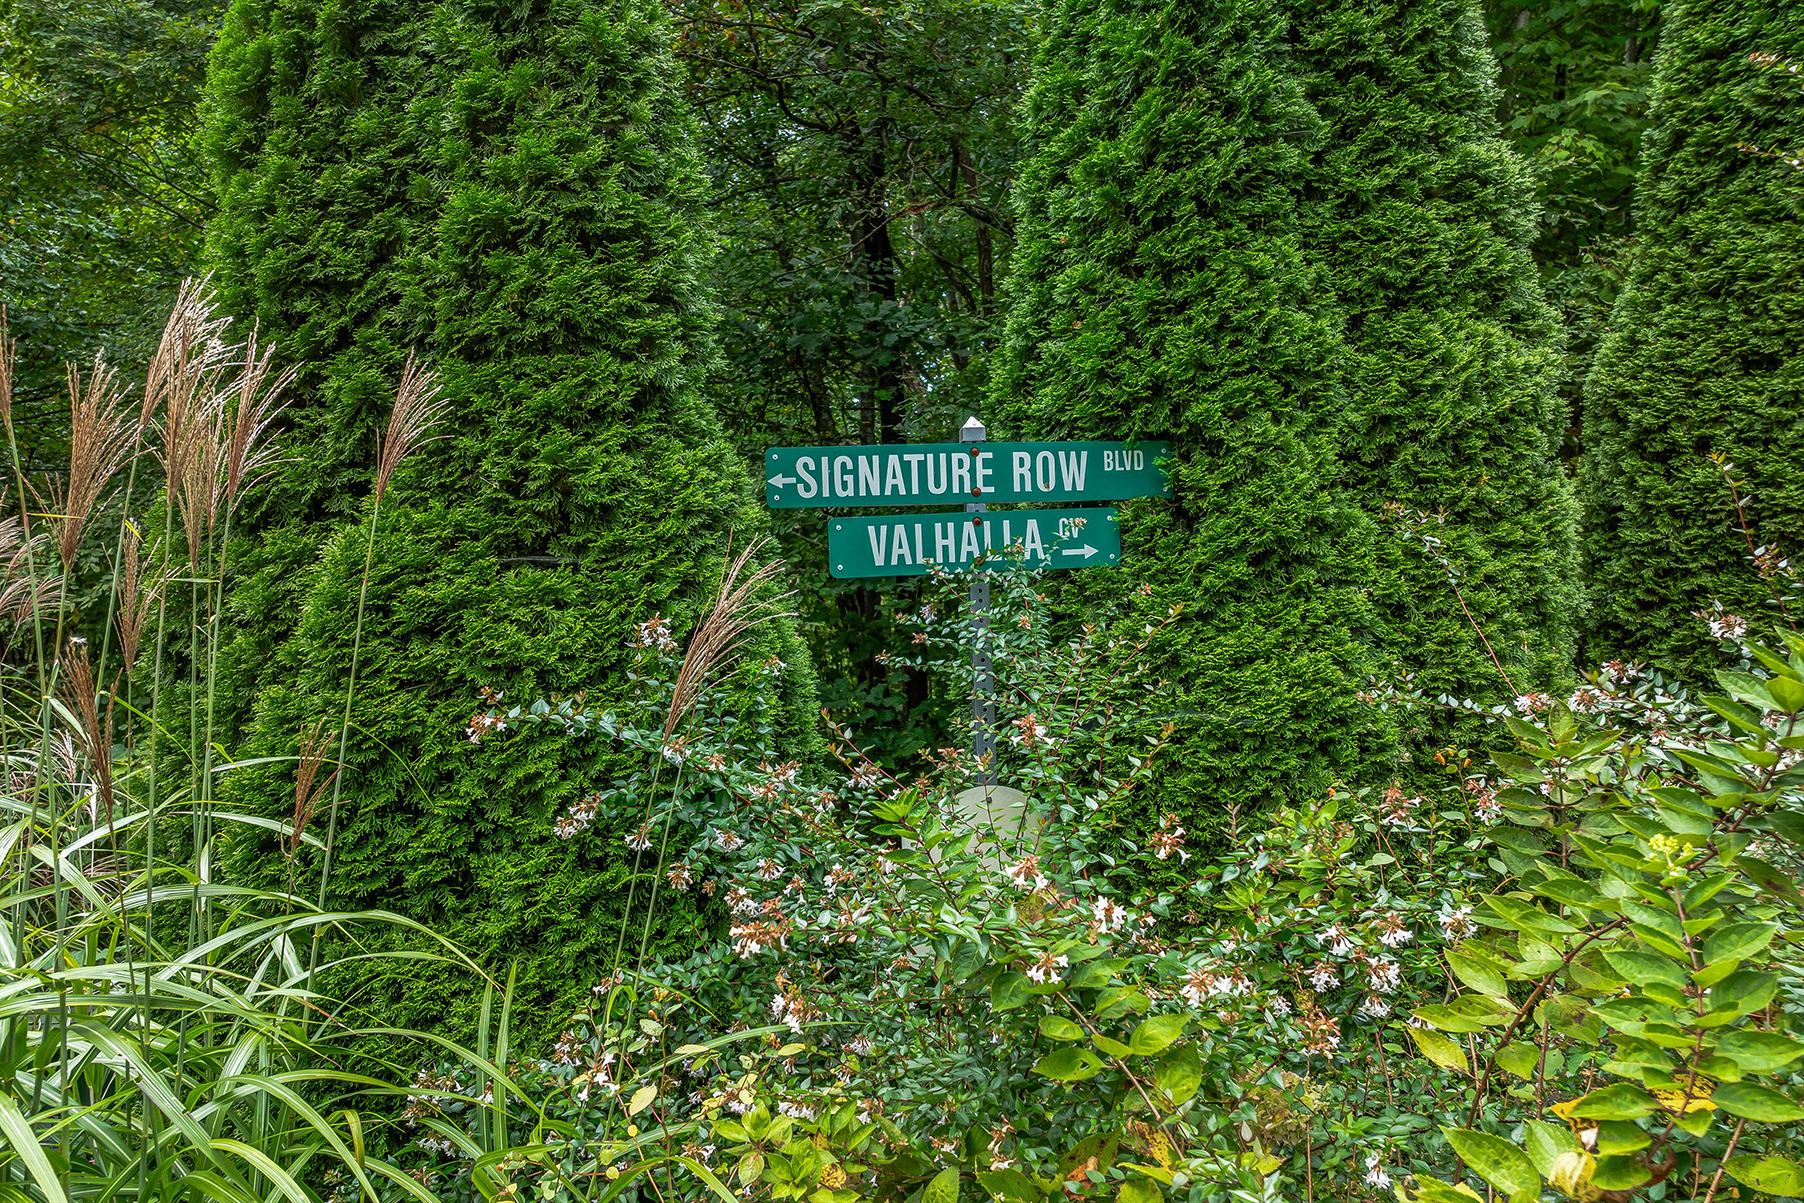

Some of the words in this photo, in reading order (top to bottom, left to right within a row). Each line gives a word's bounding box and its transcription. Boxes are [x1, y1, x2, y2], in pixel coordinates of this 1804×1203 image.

[795, 452, 995, 499] SIGNATURE
[1013, 450, 1088, 493] ROW
[1104, 450, 1145, 472] BLVD
[867, 518, 1045, 567] VALHALLA
